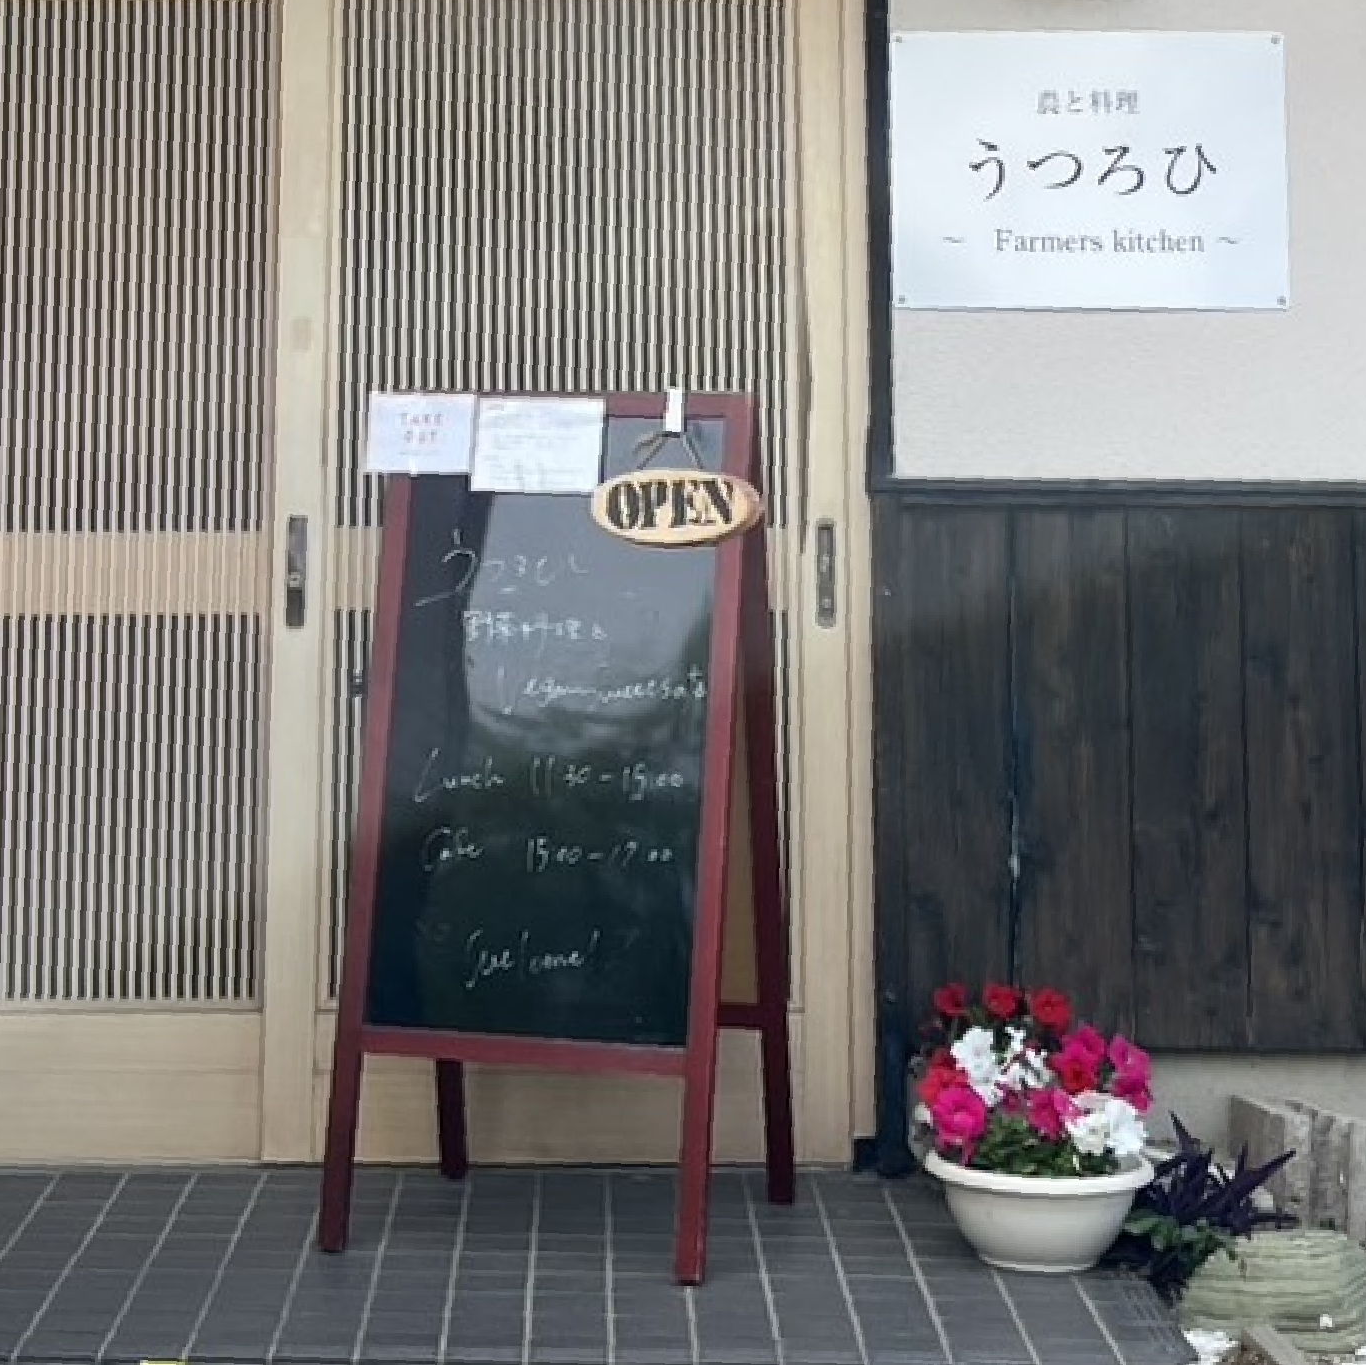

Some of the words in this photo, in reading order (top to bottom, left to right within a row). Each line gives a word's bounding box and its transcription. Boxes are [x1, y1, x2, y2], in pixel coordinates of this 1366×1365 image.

[1036, 88, 1141, 115] 農と料理
[967, 137, 1218, 202] うつろひ
[994, 227, 1104, 253] Farmers
[1112, 228, 1206, 254] kitchen
[605, 478, 735, 531] OPEN
[412, 747, 506, 804] Lunch
